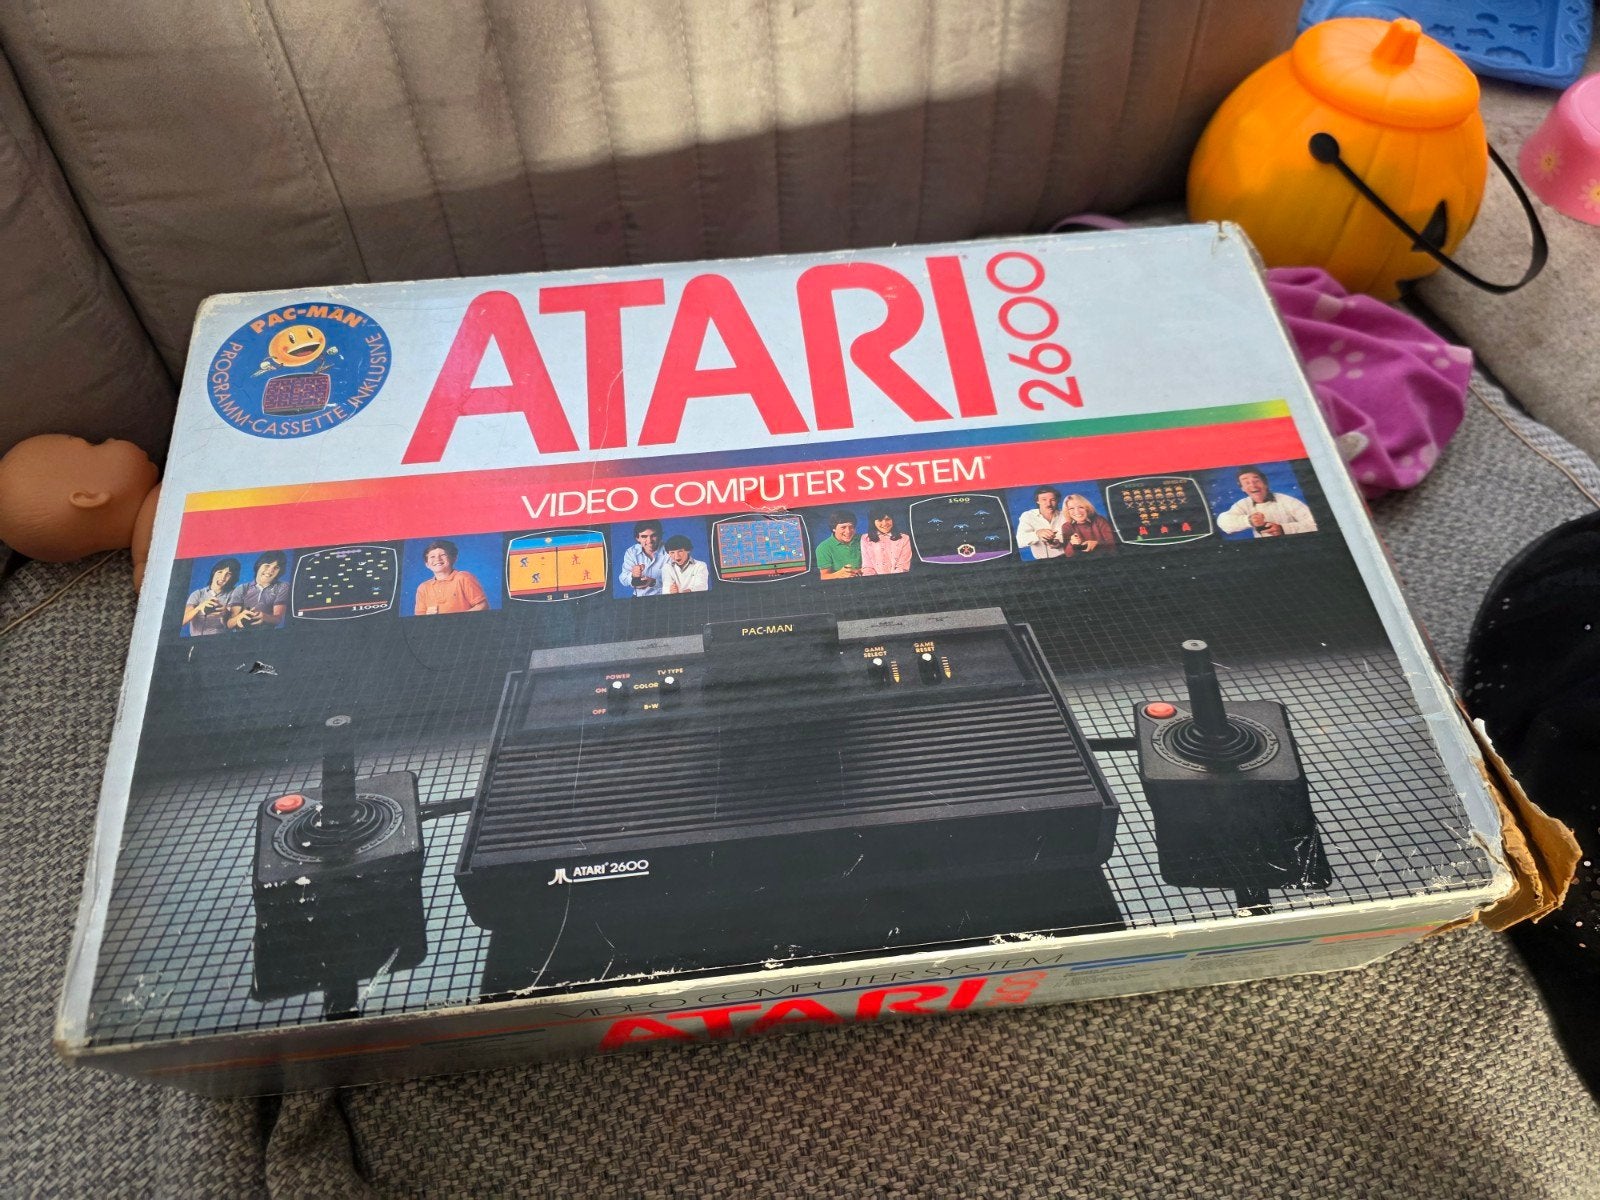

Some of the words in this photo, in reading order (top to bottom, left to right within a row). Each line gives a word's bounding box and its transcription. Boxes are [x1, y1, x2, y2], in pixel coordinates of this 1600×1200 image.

[250, 305, 363, 334] PAC-MAN
[986, 251, 1084, 411] 2600
[212, 341, 348, 436] PROGRAMM-CASSETTE
[347, 332, 388, 410] INKLUSIVE
[401, 255, 998, 465] ATARI
[521, 487, 638, 519] VIDEO
[649, 469, 845, 509] COMPUTER
[741, 624, 793, 636] PAC-MAN
[863, 650, 887, 658] SELECT
[633, 682, 659, 690] COLOR
[610, 859, 649, 873] 2600
[554, 998, 687, 1018] VIDEO
[698, 970, 915, 1003] COMPUTER
[925, 953, 1064, 978] SYSTEM
[599, 976, 988, 1053] ATARI
